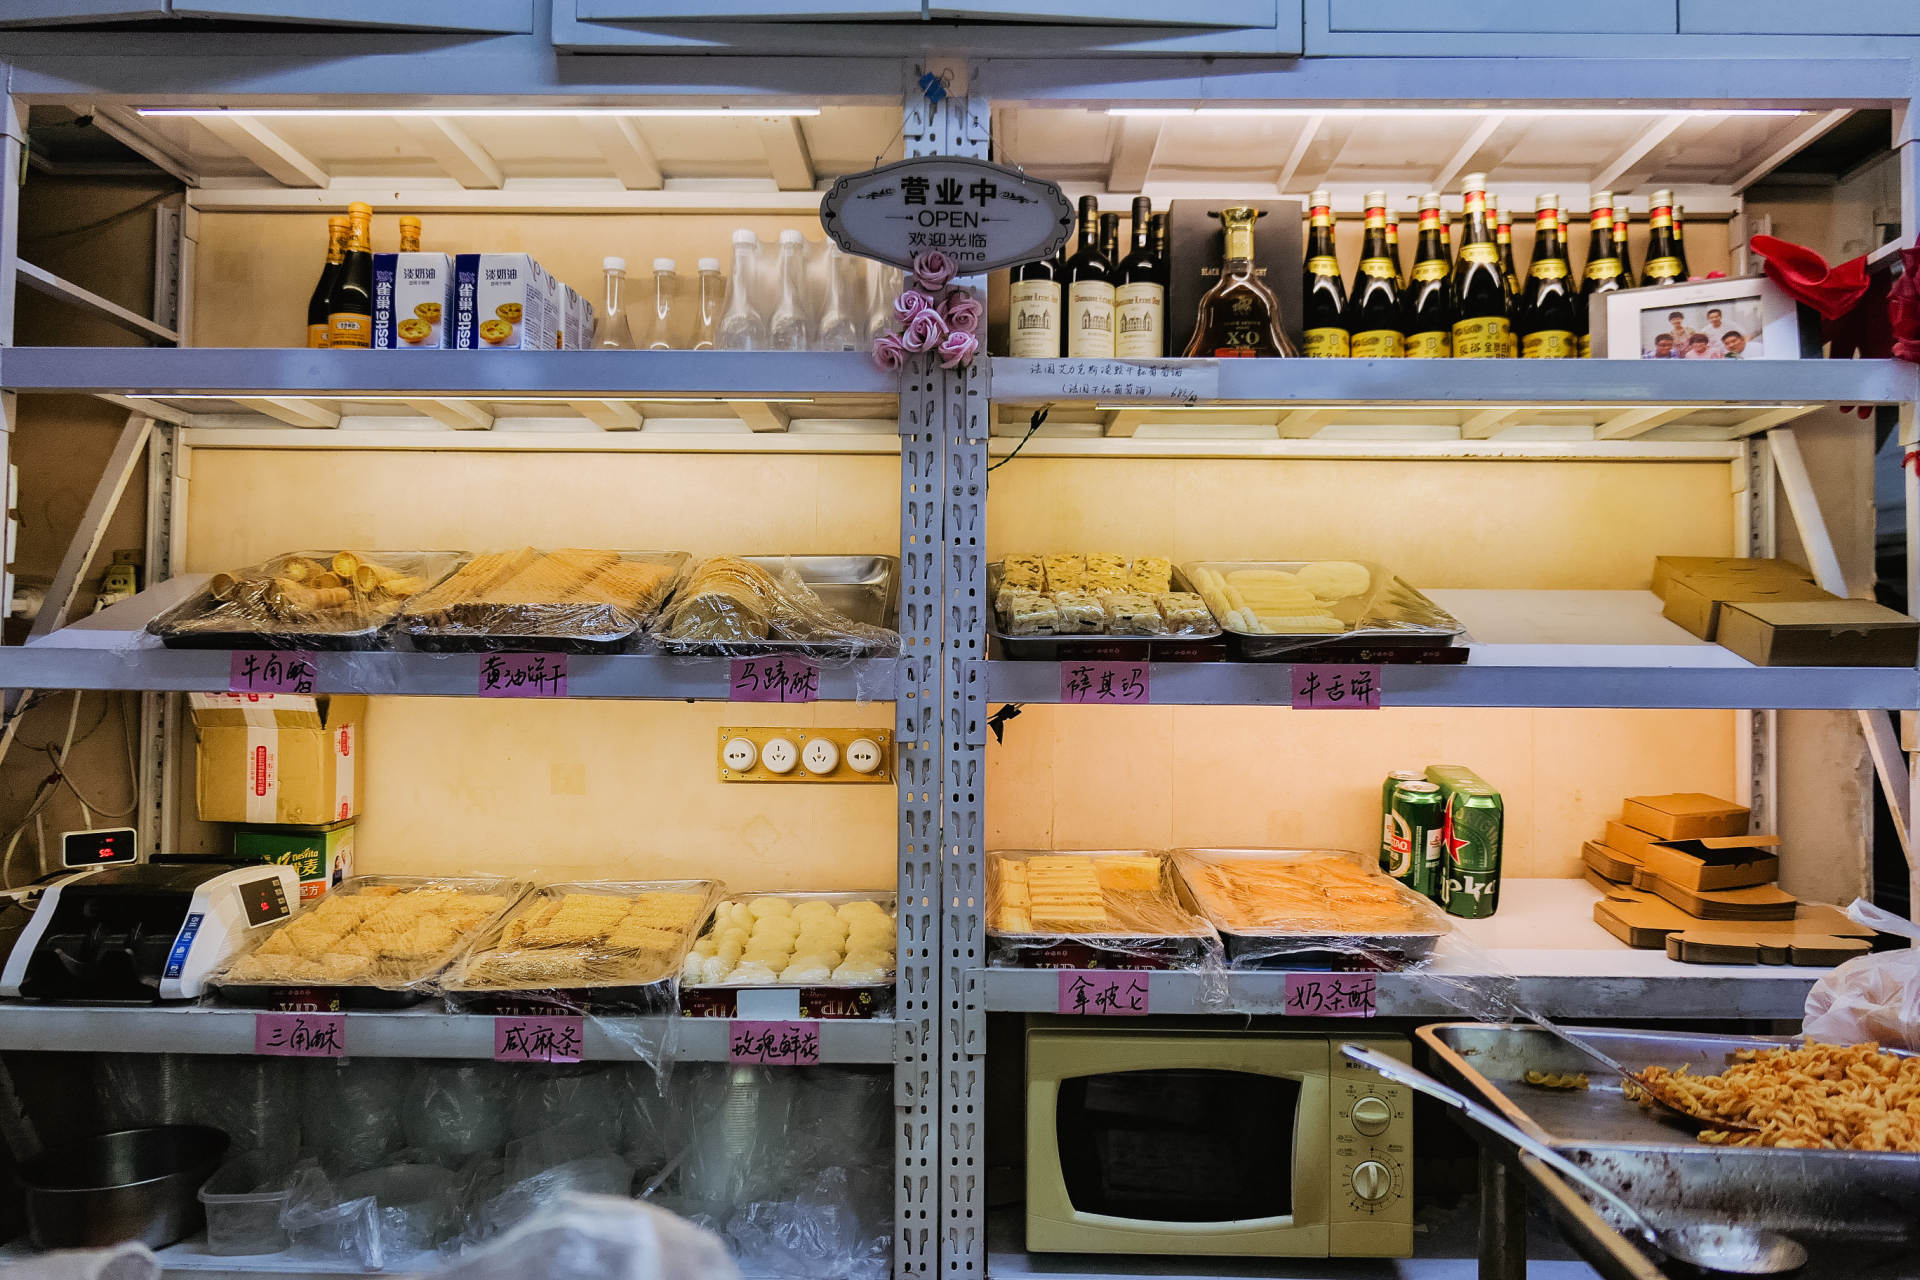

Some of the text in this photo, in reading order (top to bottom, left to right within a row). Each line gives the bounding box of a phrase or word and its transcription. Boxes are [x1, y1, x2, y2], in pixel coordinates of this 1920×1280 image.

[900, 176, 997, 207] 营业中
[918, 210, 978, 228] OPEN
[908, 231, 987, 248] 欢迎光临
[403, 268, 436, 280] 淡奶油
[485, 268, 519, 281] 淡奶油
[376, 281, 393, 310] 雀巢
[458, 283, 475, 311] 雀巢
[241, 654, 314, 689] 牛角酥
[481, 656, 566, 694] 黄油饼干
[736, 661, 817, 702] 马蹄酥
[1300, 671, 1373, 706] 牛舌饼
[821, 1000, 861, 1016] VIP
[1068, 976, 1148, 1015] 拿破仑
[266, 1019, 342, 1054] 三角酥
[732, 1026, 819, 1063] 玫瑰鲜花
